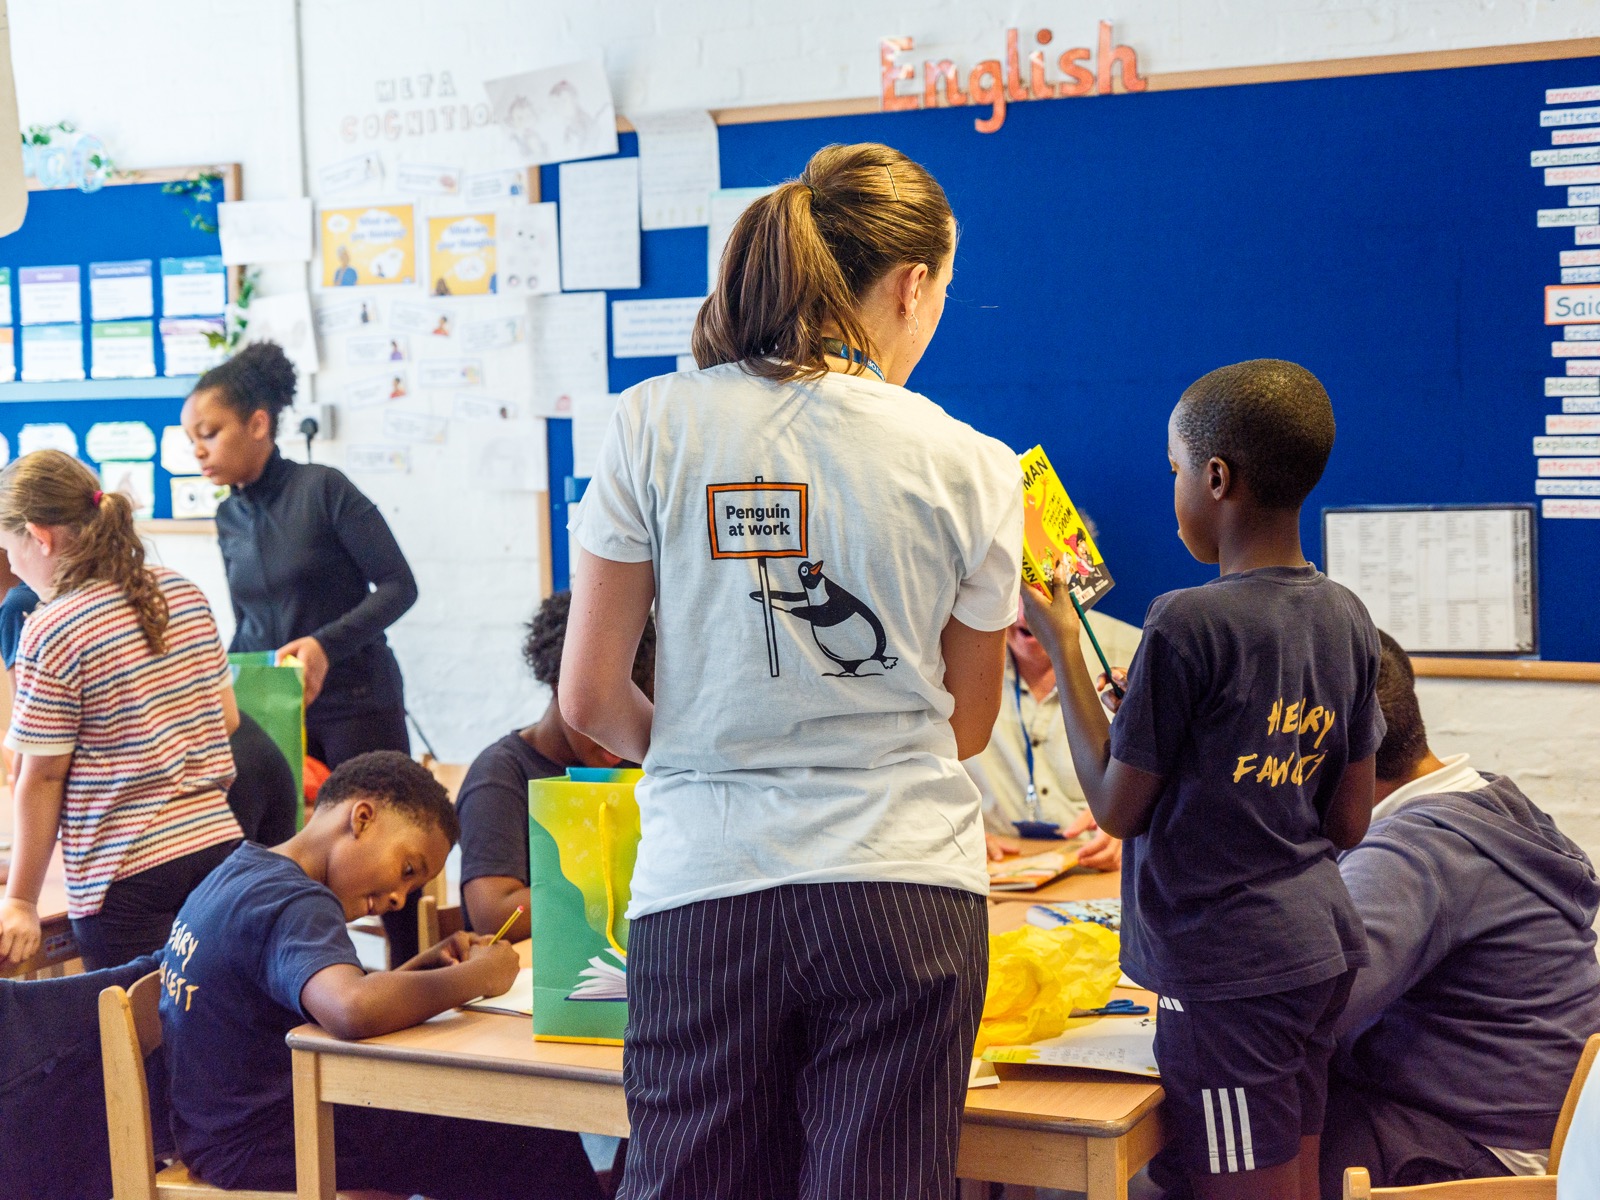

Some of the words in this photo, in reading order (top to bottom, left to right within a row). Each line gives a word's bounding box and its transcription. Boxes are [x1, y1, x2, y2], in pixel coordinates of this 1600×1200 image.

[879, 20, 1147, 133] English
[1023, 456, 1048, 491] MAN
[726, 503, 790, 522] Penguin
[728, 523, 745, 536] at
[748, 522, 790, 536] work
